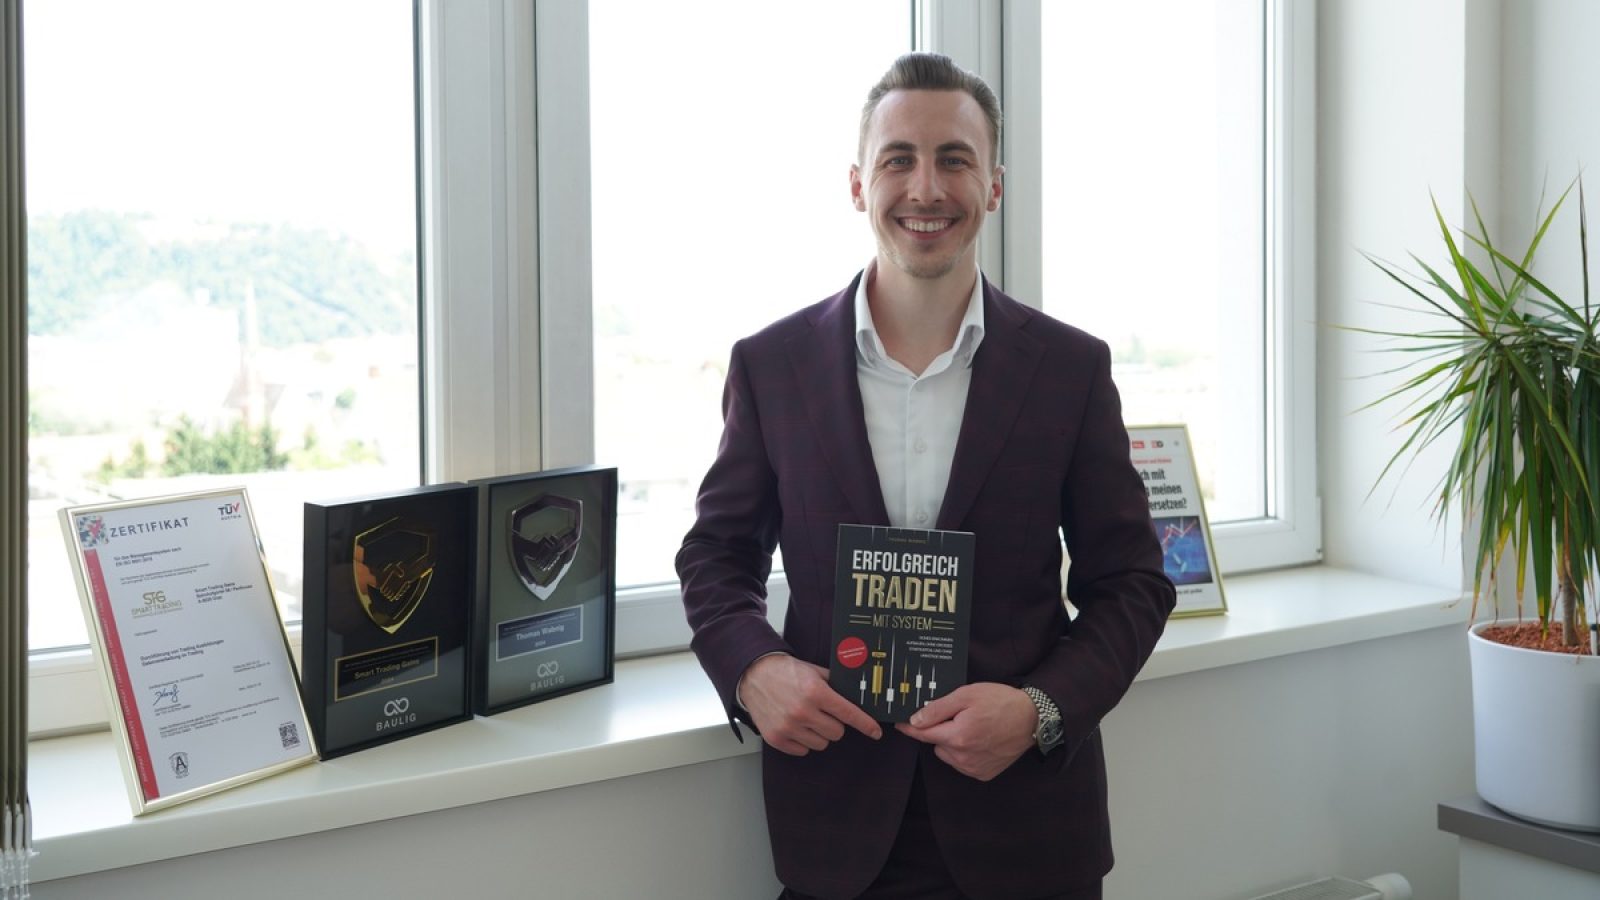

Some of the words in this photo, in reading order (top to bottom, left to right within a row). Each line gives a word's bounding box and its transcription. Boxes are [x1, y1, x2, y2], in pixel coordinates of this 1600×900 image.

[1151, 483, 1182, 495] meinen
[218, 502, 240, 515] TÜV
[110, 517, 189, 538] ZERTIFIKAT
[852, 549, 959, 577] ERFOLGREICH
[852, 573, 957, 613] TRADEN
[873, 613, 889, 627] MIT
[892, 615, 932, 631] SYSTEM
[516, 631, 541, 641] Thomas
[354, 670, 374, 680] Smart
[376, 664, 400, 675] Trading
[530, 676, 565, 692] BAULIG
[376, 713, 416, 731] BAULIG
